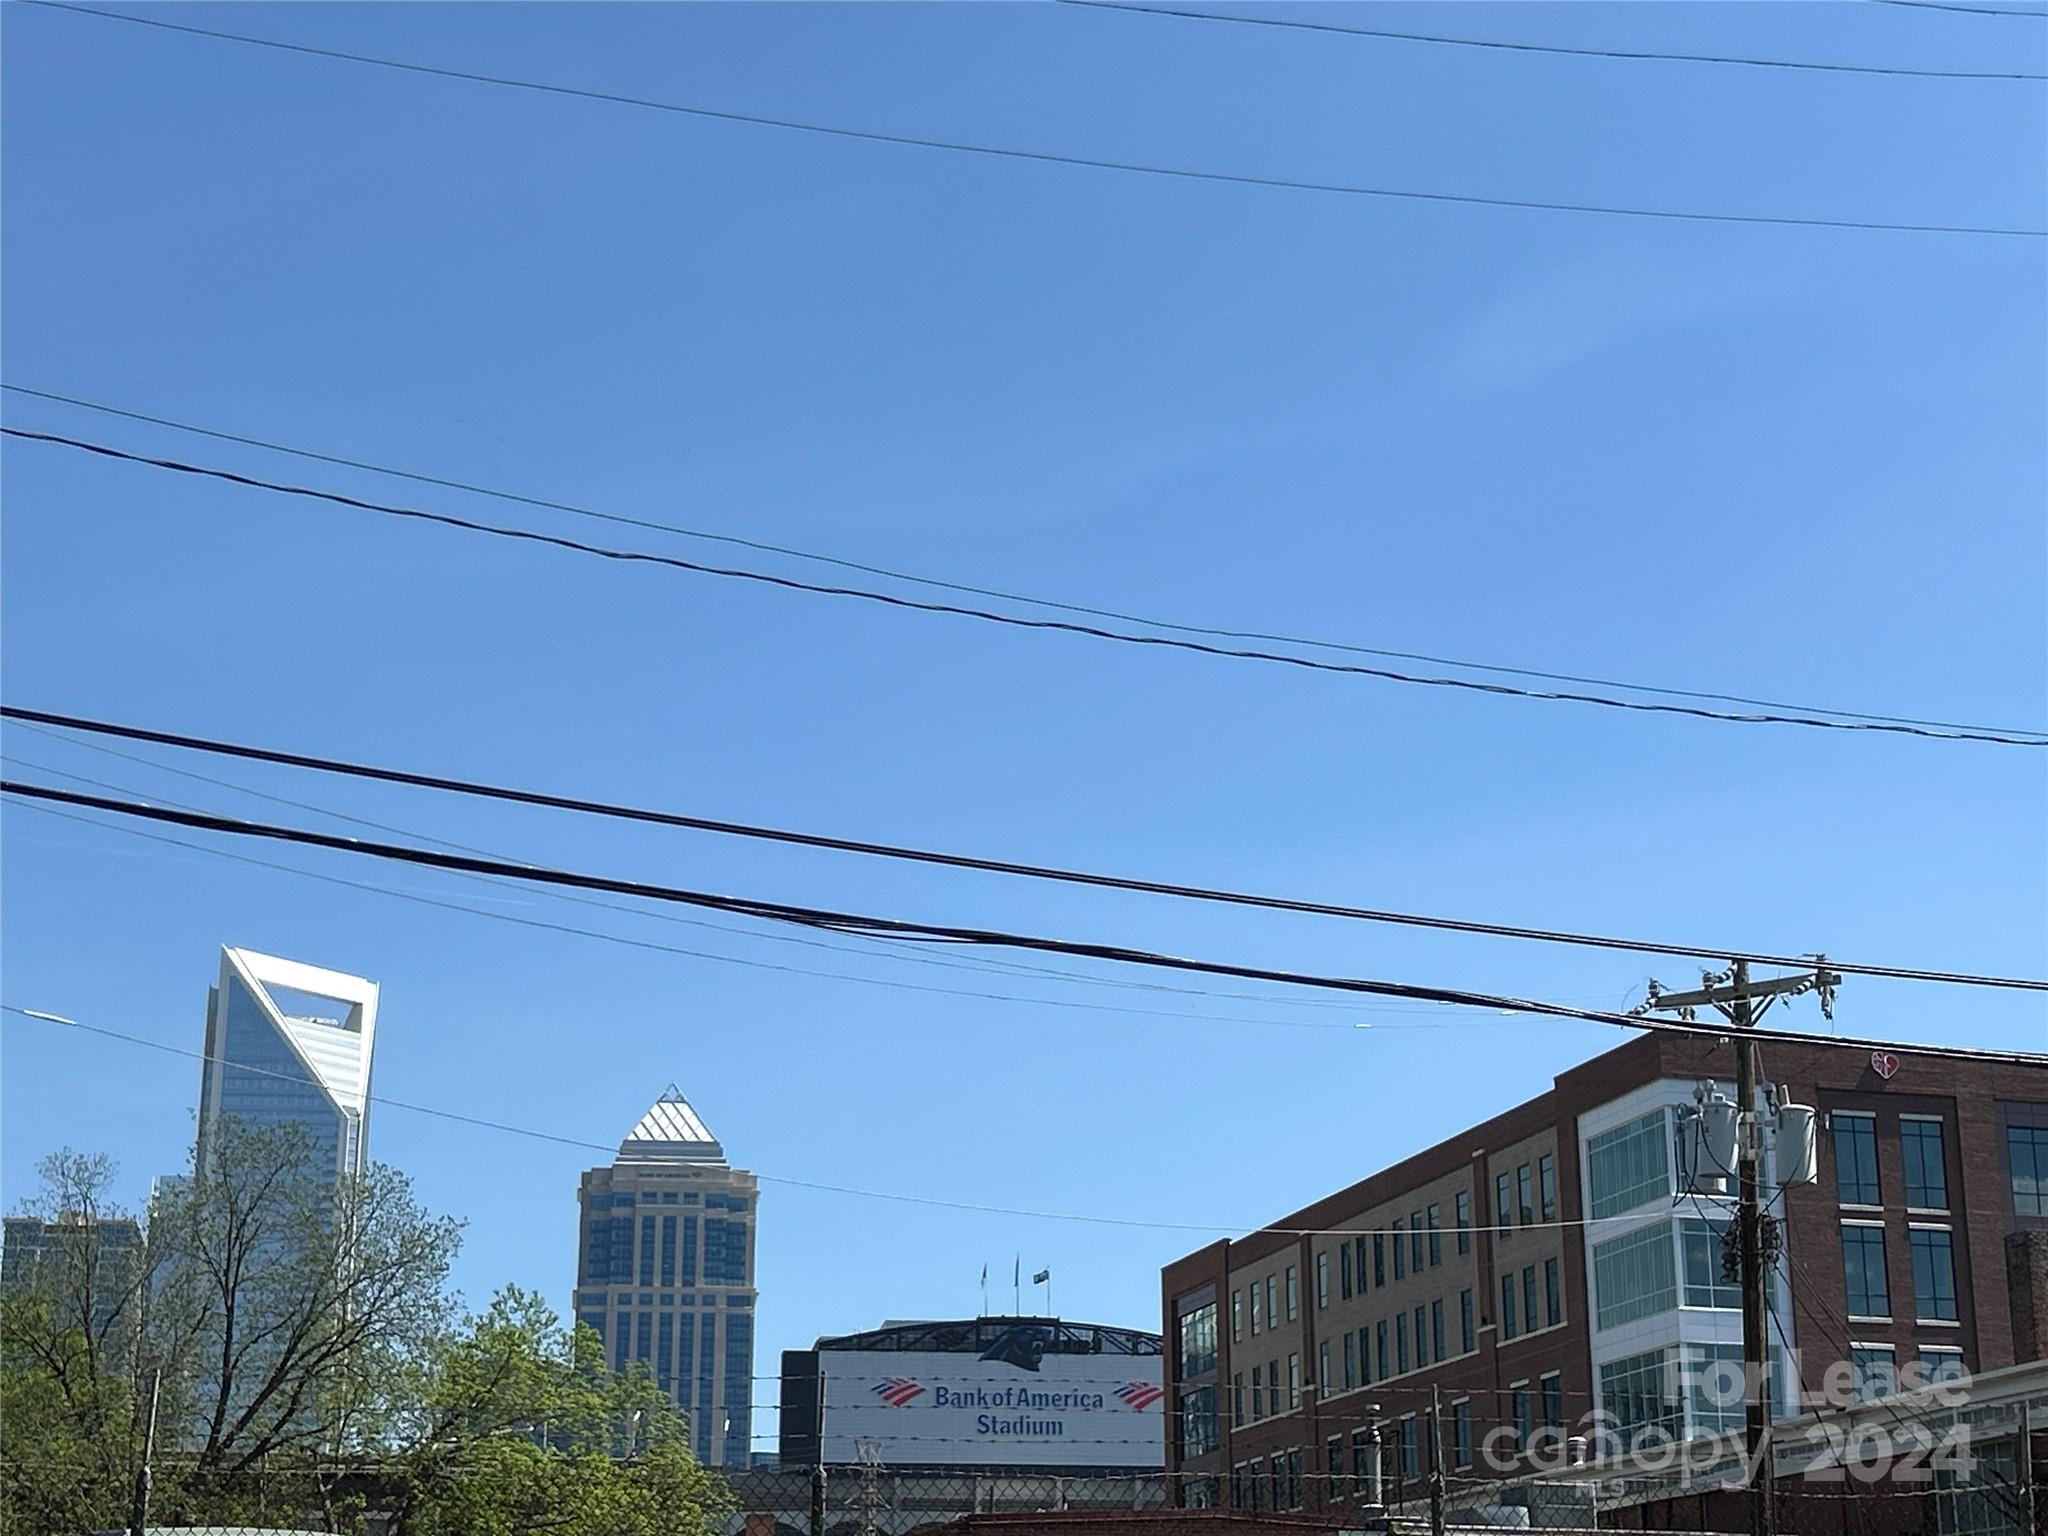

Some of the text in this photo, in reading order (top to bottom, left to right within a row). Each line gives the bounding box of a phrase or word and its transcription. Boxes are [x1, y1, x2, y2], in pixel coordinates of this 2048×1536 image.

[935, 1386, 1104, 1409] Bank of America
[977, 1414, 1063, 1436] Stadium
